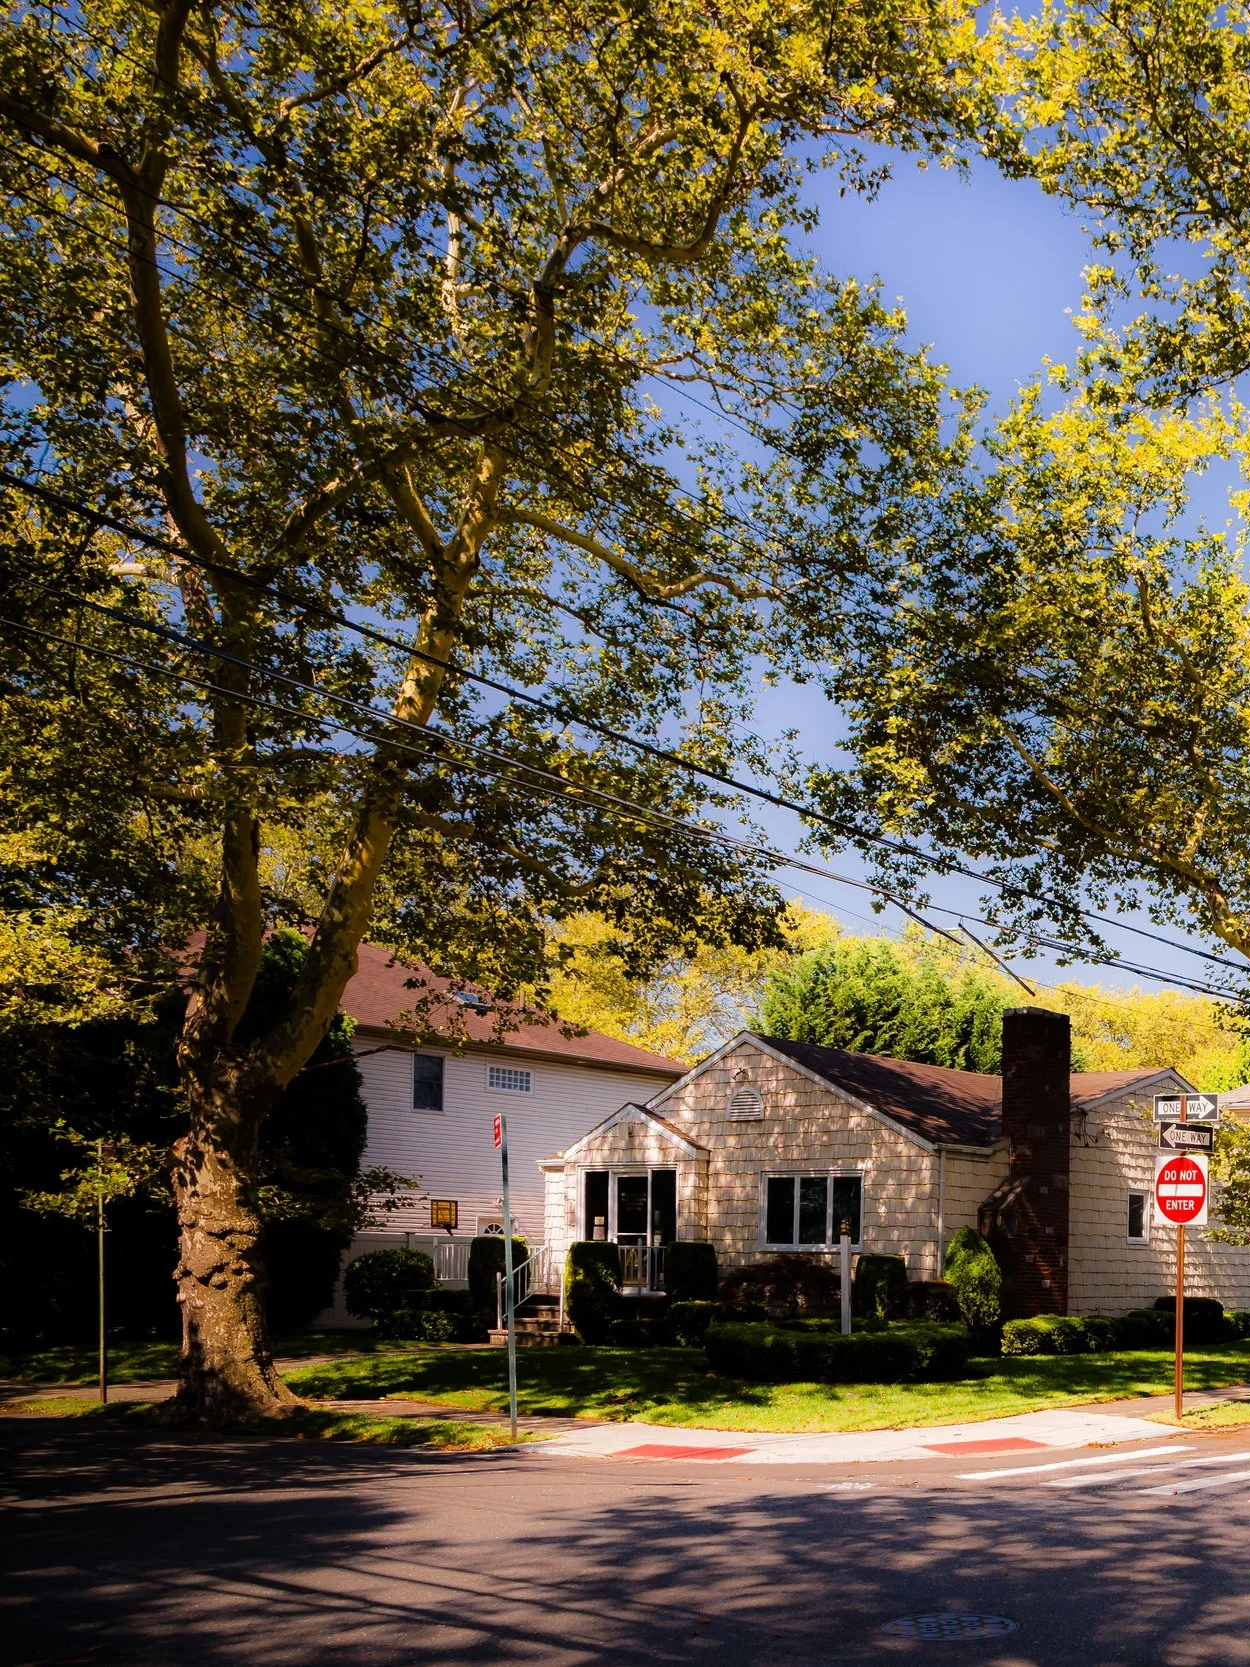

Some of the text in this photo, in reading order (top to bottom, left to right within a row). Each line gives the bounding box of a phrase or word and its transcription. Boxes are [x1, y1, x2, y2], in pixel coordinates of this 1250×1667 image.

[1163, 1102, 1208, 1113] ONE WAY
[1170, 1131, 1206, 1144] ONE WAY
[1164, 1170, 1197, 1181] DO NOT
[1166, 1200, 1195, 1211] ENTER
